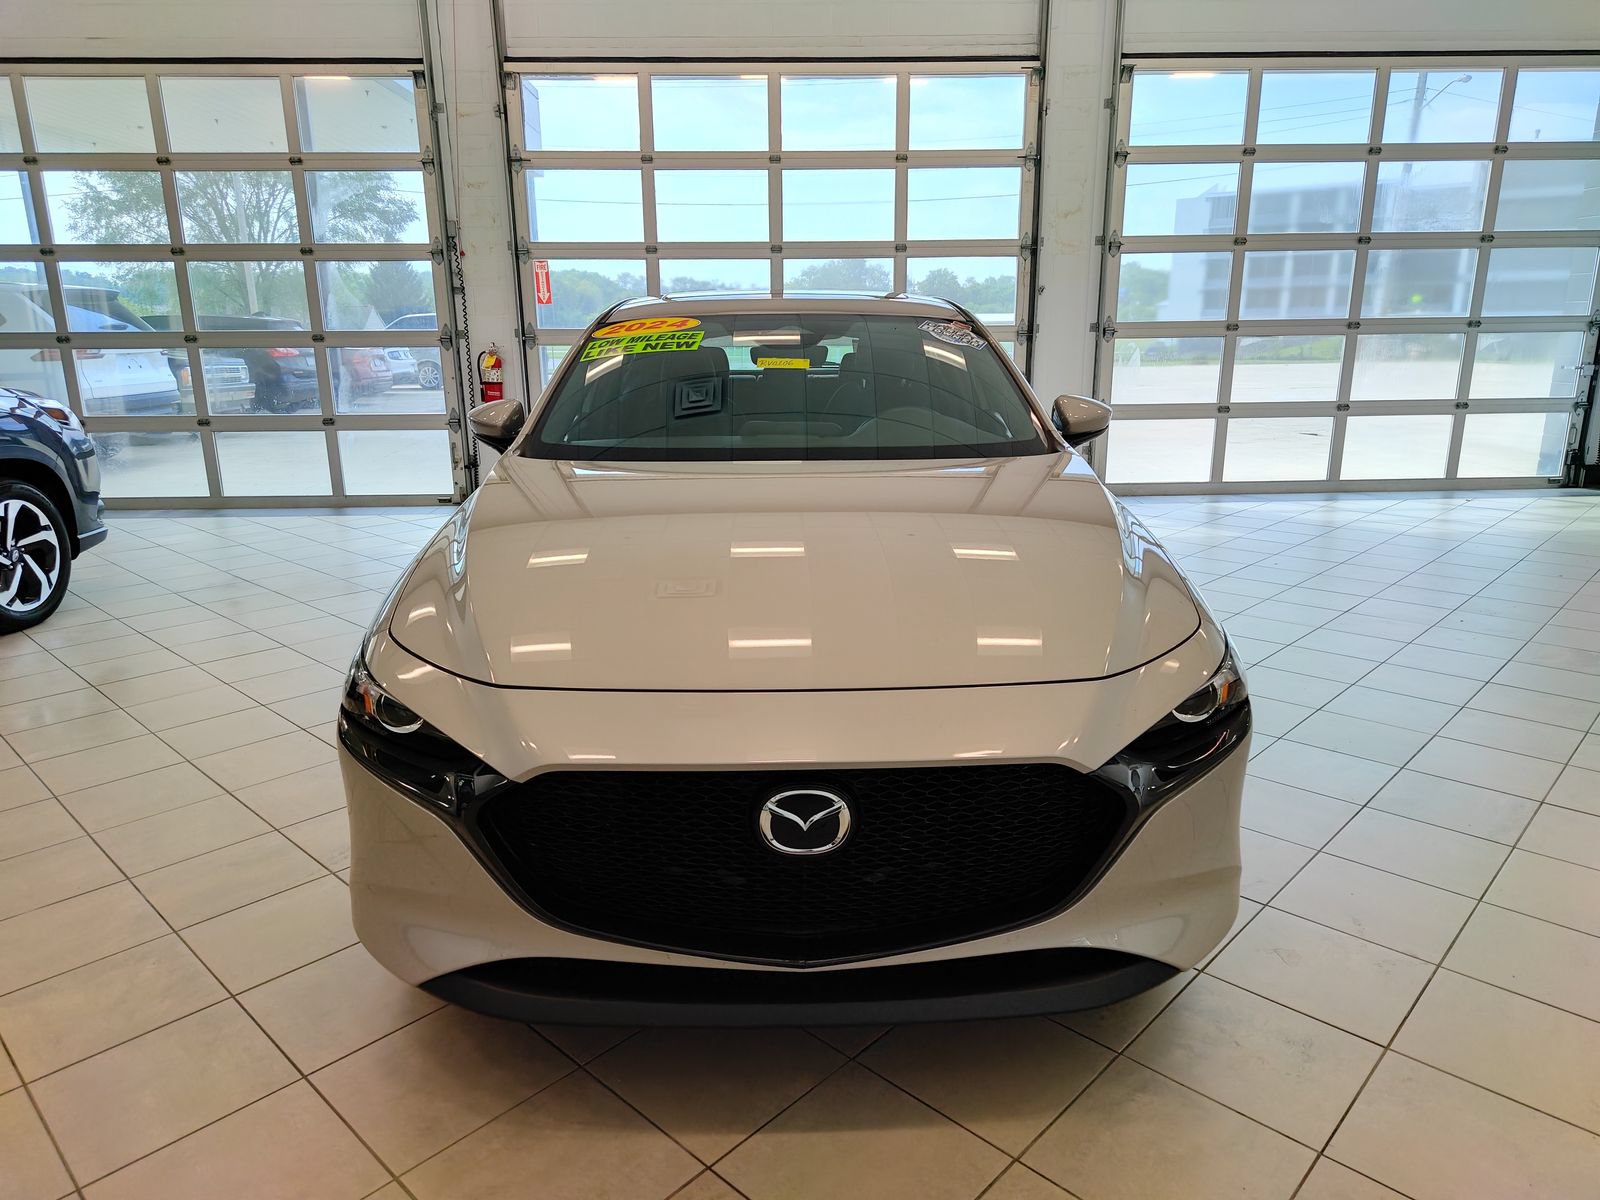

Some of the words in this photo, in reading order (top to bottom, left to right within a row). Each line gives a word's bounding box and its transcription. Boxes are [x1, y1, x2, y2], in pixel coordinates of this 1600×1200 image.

[601, 319, 690, 336] 2024
[583, 344, 637, 358] LIKE
[641, 341, 697, 351] NEW
[588, 338, 625, 350] LOW
[626, 332, 700, 344] MILEAGE
